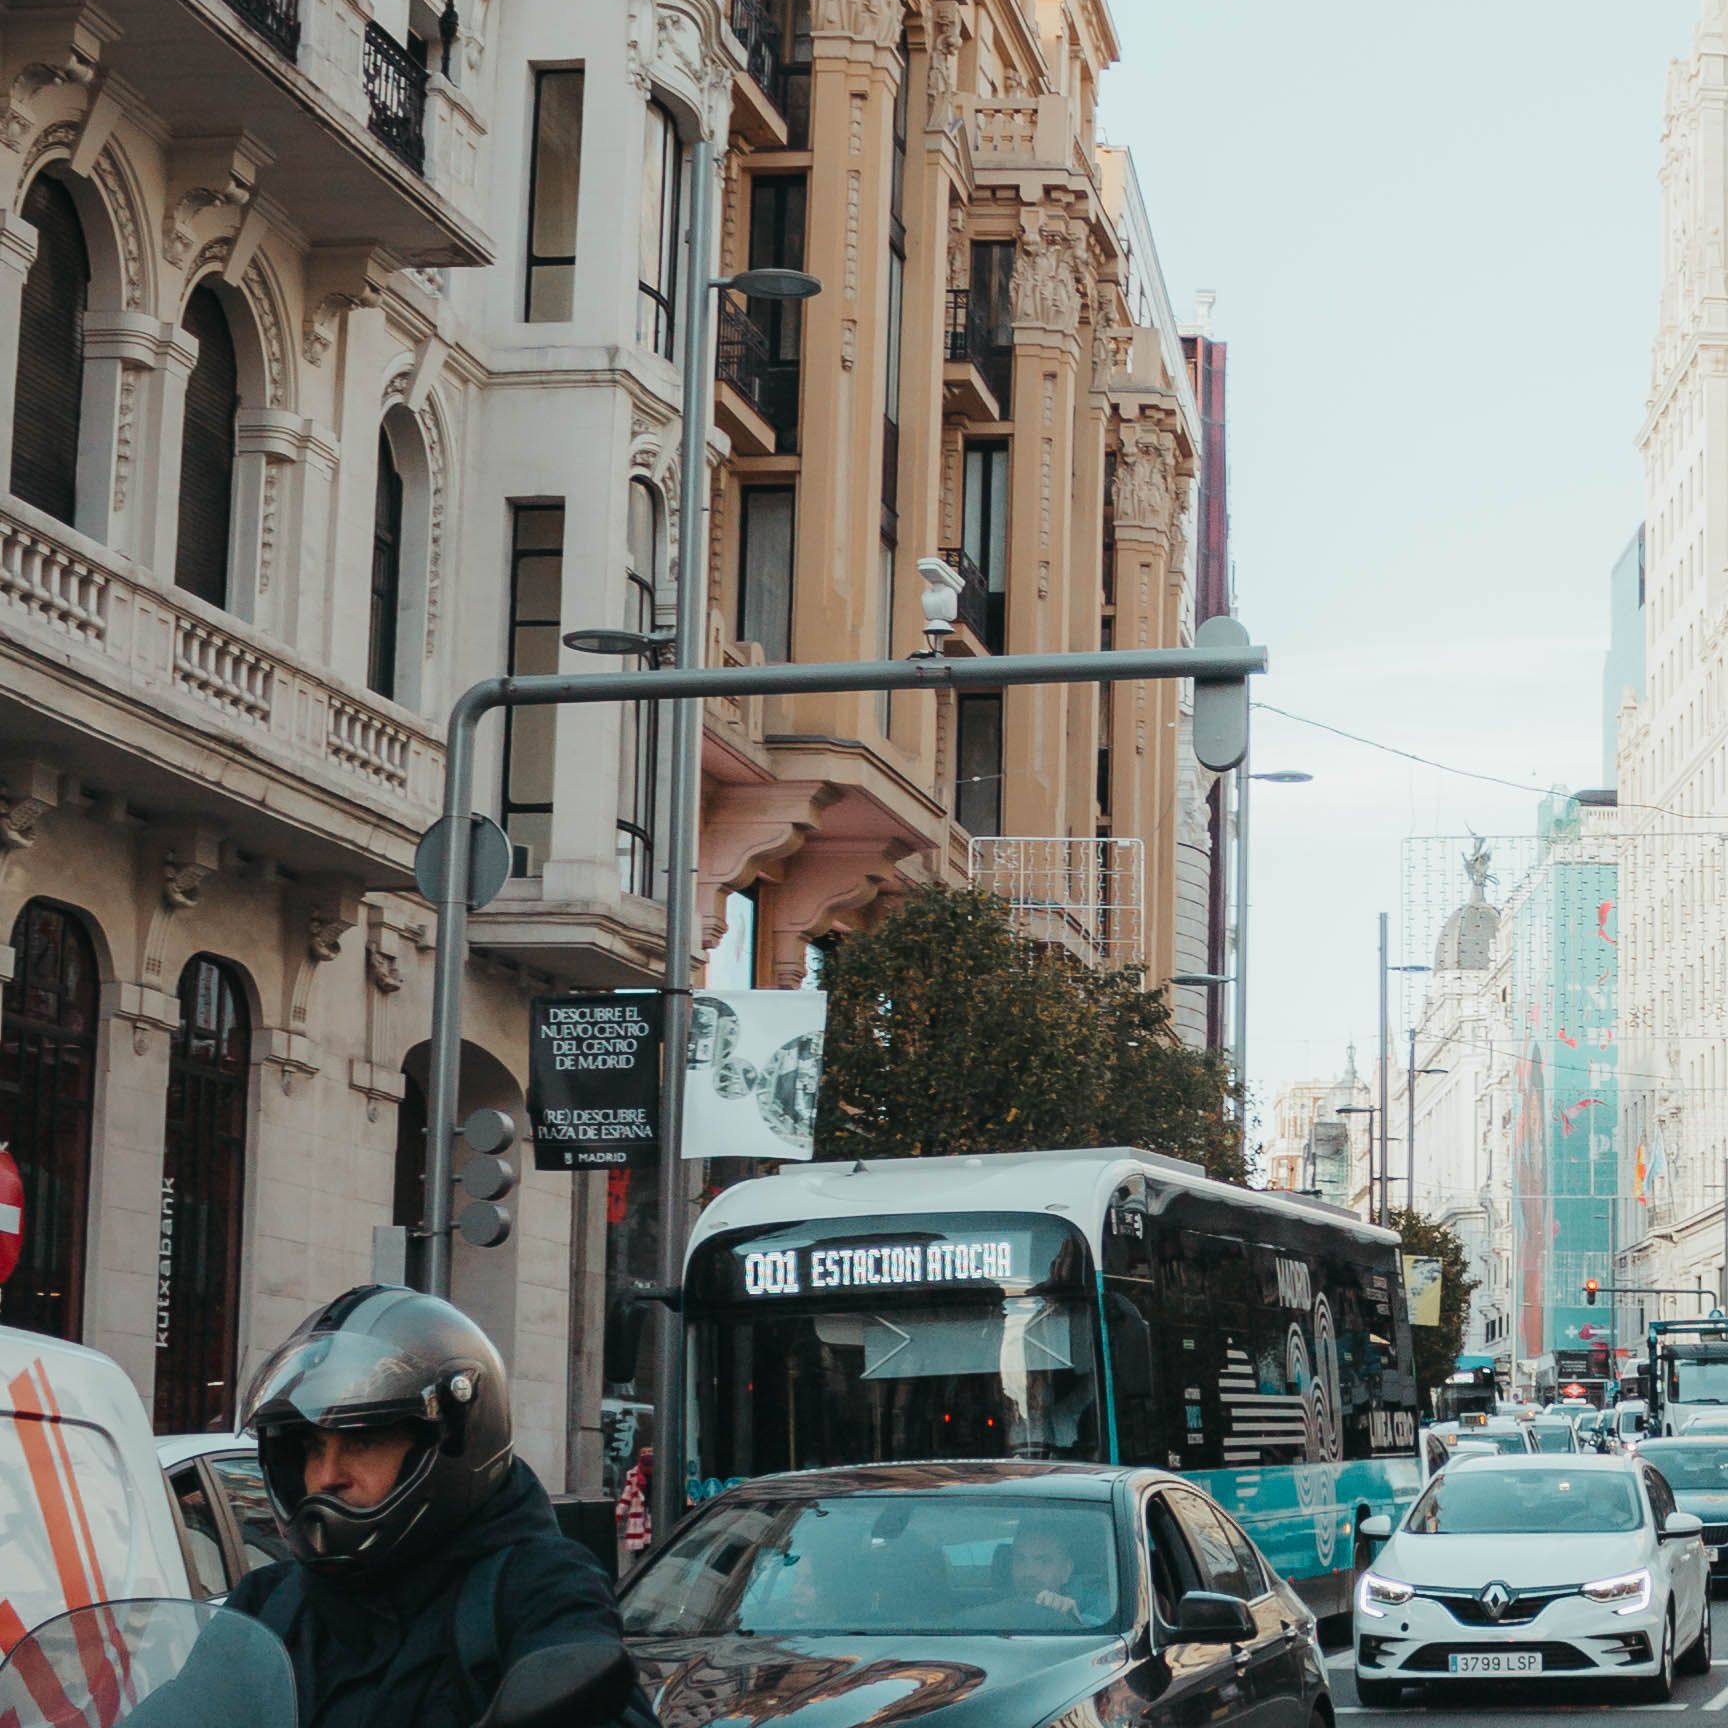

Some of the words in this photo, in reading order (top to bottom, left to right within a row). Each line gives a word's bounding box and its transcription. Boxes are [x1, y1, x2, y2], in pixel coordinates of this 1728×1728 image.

[549, 1008, 622, 1023] DESCUBRE
[625, 1007, 642, 1021] EL
[541, 1024, 592, 1039] NUEVO
[594, 1023, 649, 1038] CENTRO
[553, 1040, 581, 1055] DEL
[583, 1039, 638, 1053] CENTRO
[556, 1056, 577, 1070] DE
[578, 1055, 635, 1069] MADRID
[544, 1109, 571, 1124] (RE)
[573, 1109, 647, 1124] DESCUBRE
[538, 1126, 576, 1140] PLAZA
[578, 1126, 599, 1139] DE
[601, 1122, 653, 1139] ESPAÑA
[578, 1152, 627, 1163] MADRID
[155, 1177, 175, 1348] kutxabank
[745, 1251, 800, 1295] 001
[812, 1246, 922, 1287] ESTACION
[926, 1241, 1011, 1282] ATOCHA
[1460, 1656, 1501, 1672] 3799
[1506, 1655, 1537, 1671] LSP
